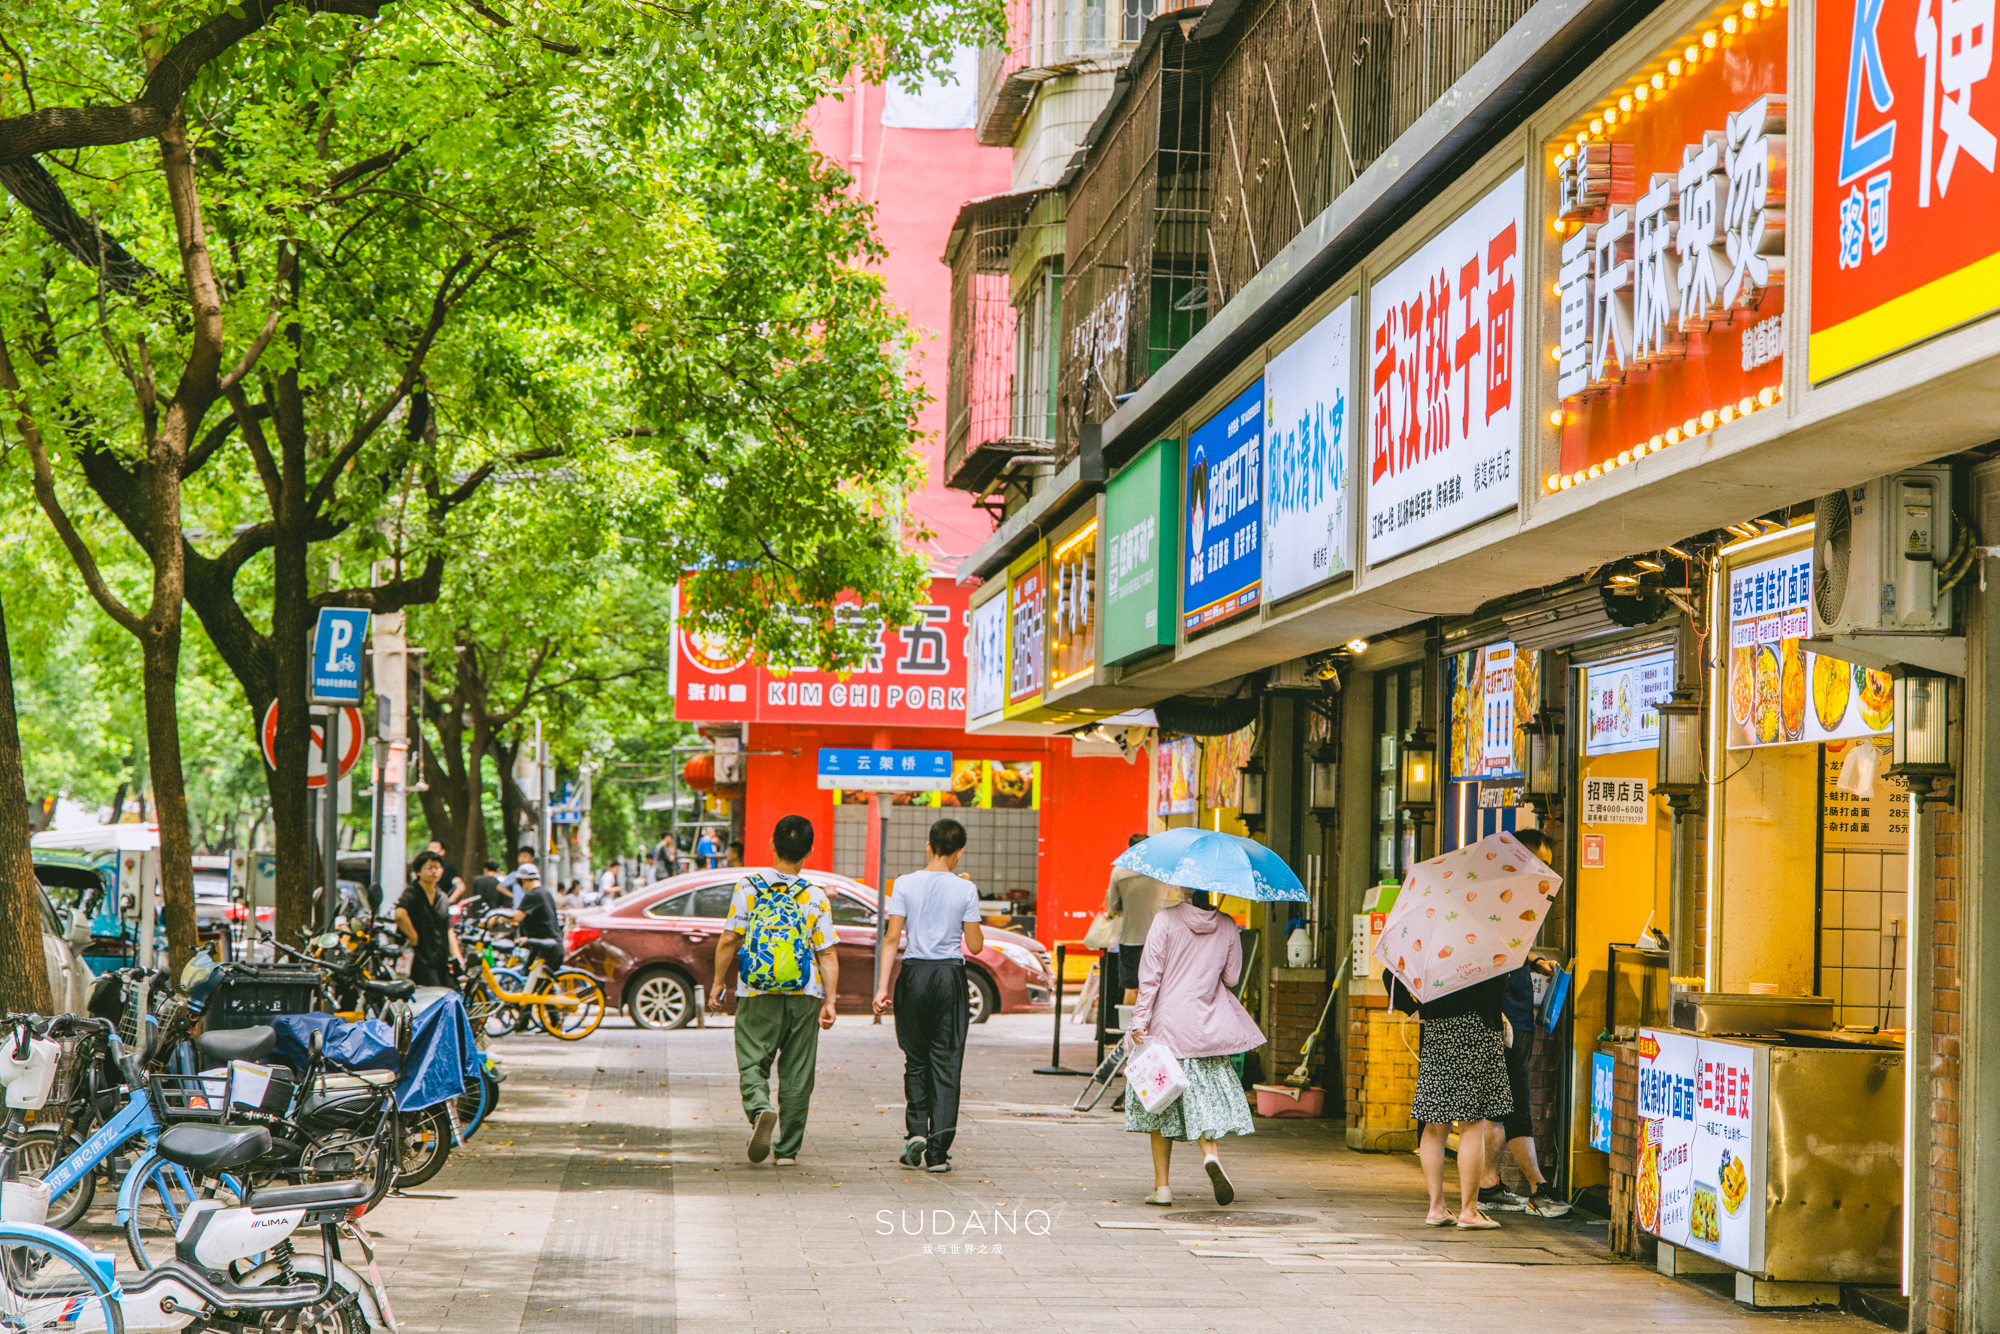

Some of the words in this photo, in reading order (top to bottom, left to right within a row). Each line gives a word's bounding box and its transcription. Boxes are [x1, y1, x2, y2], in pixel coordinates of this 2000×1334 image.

[1558, 142, 1588, 219] 正宗
[1558, 95, 1769, 400] 重庆麻辣烫
[1372, 217, 1516, 486] 武汉热干面
[1741, 313, 1784, 372] 粮道街
[1733, 562, 1810, 617] 楚天首佳打卤面
[325, 619, 353, 672] P
[768, 682, 822, 706] KIM
[829, 683, 880, 708] CHI
[887, 686, 966, 710] PORK
[857, 756, 916, 771] 云架桥
[1588, 781, 1644, 802] 招聘店员
[1588, 804, 1643, 813] 工资4000-6000
[1889, 793, 1910, 803] 28元
[1889, 809, 1909, 818] 28元
[1889, 824, 1909, 834] 25元
[1640, 1067, 1695, 1122] 秘制打卤面
[1704, 1061, 1750, 1120] 三鲜豆皮
[261, 1217, 289, 1228] LIMA
